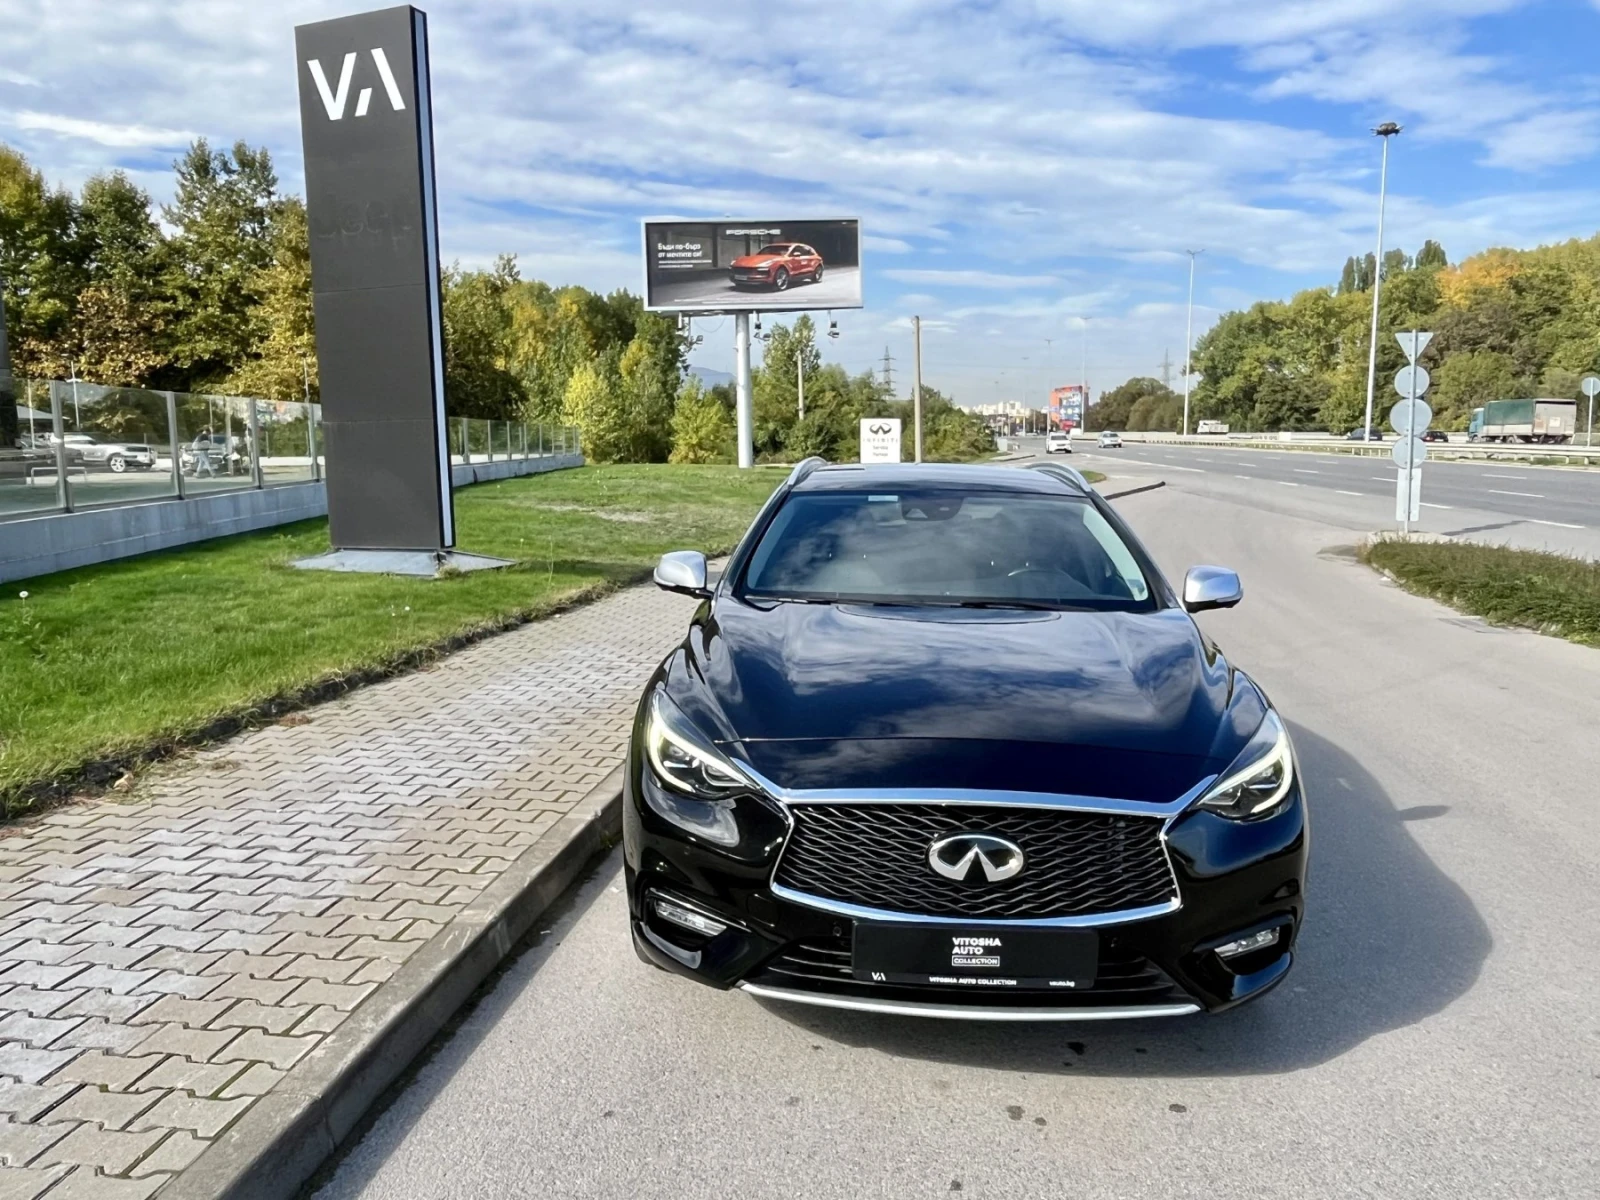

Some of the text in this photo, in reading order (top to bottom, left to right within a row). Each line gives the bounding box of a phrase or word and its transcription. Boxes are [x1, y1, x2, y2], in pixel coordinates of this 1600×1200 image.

[952, 936, 1002, 947] VITOSHA
[952, 946, 984, 956] AUTO
[953, 957, 999, 966] COLLECTION
[929, 976, 1017, 986] VITOSHA AUTO COLLECTION
